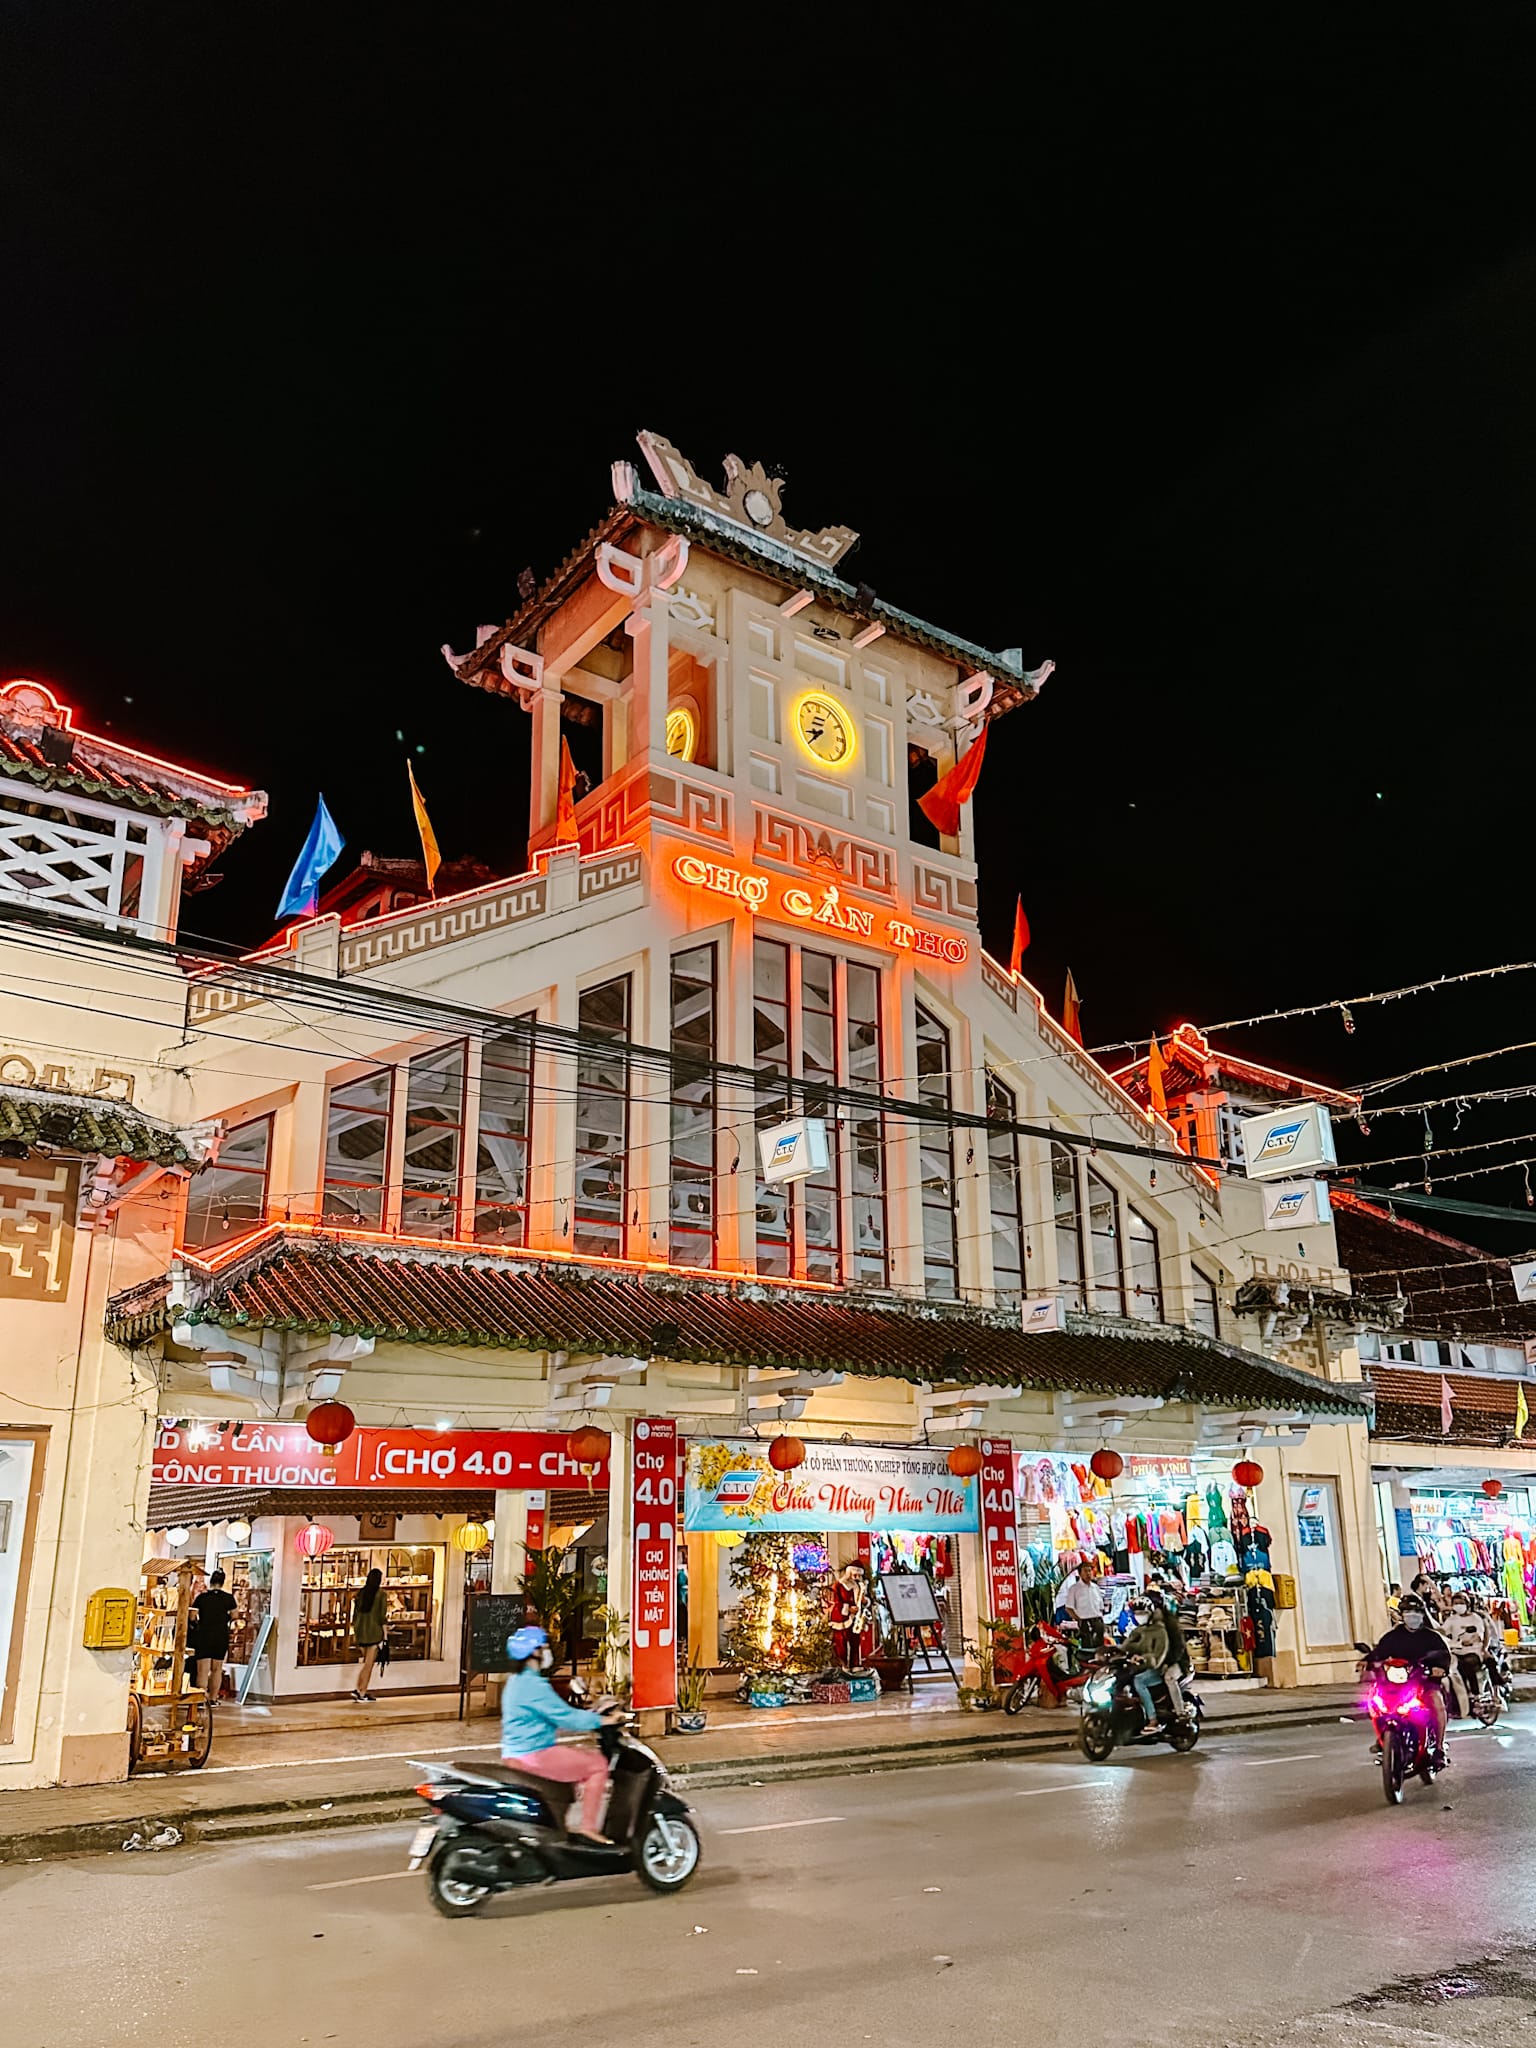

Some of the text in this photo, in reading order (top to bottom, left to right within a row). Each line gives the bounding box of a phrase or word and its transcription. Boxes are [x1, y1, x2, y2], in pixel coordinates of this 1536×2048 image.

[672, 856, 968, 964] CHỢ CẦN THƠ
[776, 1144, 794, 1156] C.T.C
[1267, 1134, 1295, 1148] C.T.C
[231, 1426, 282, 1454] CẦN
[290, 1436, 343, 1455] TH
[151, 1458, 337, 1485] CÔNG THƯƠNG
[384, 1446, 456, 1479] CHỢ
[462, 1451, 513, 1475] 4.0
[636, 1452, 665, 1473] Chợ
[983, 1466, 1005, 1484] Chợ
[635, 1477, 675, 1506] 4.0
[722, 1481, 752, 1494] C.T.C
[772, 1481, 965, 1524] Chúc Mừng Năm Mới
[985, 1488, 1014, 1512] 4.0
[646, 1550, 664, 1564] CHỢ
[639, 1566, 670, 1581] KHÔNG
[644, 1606, 664, 1623] MẶT
